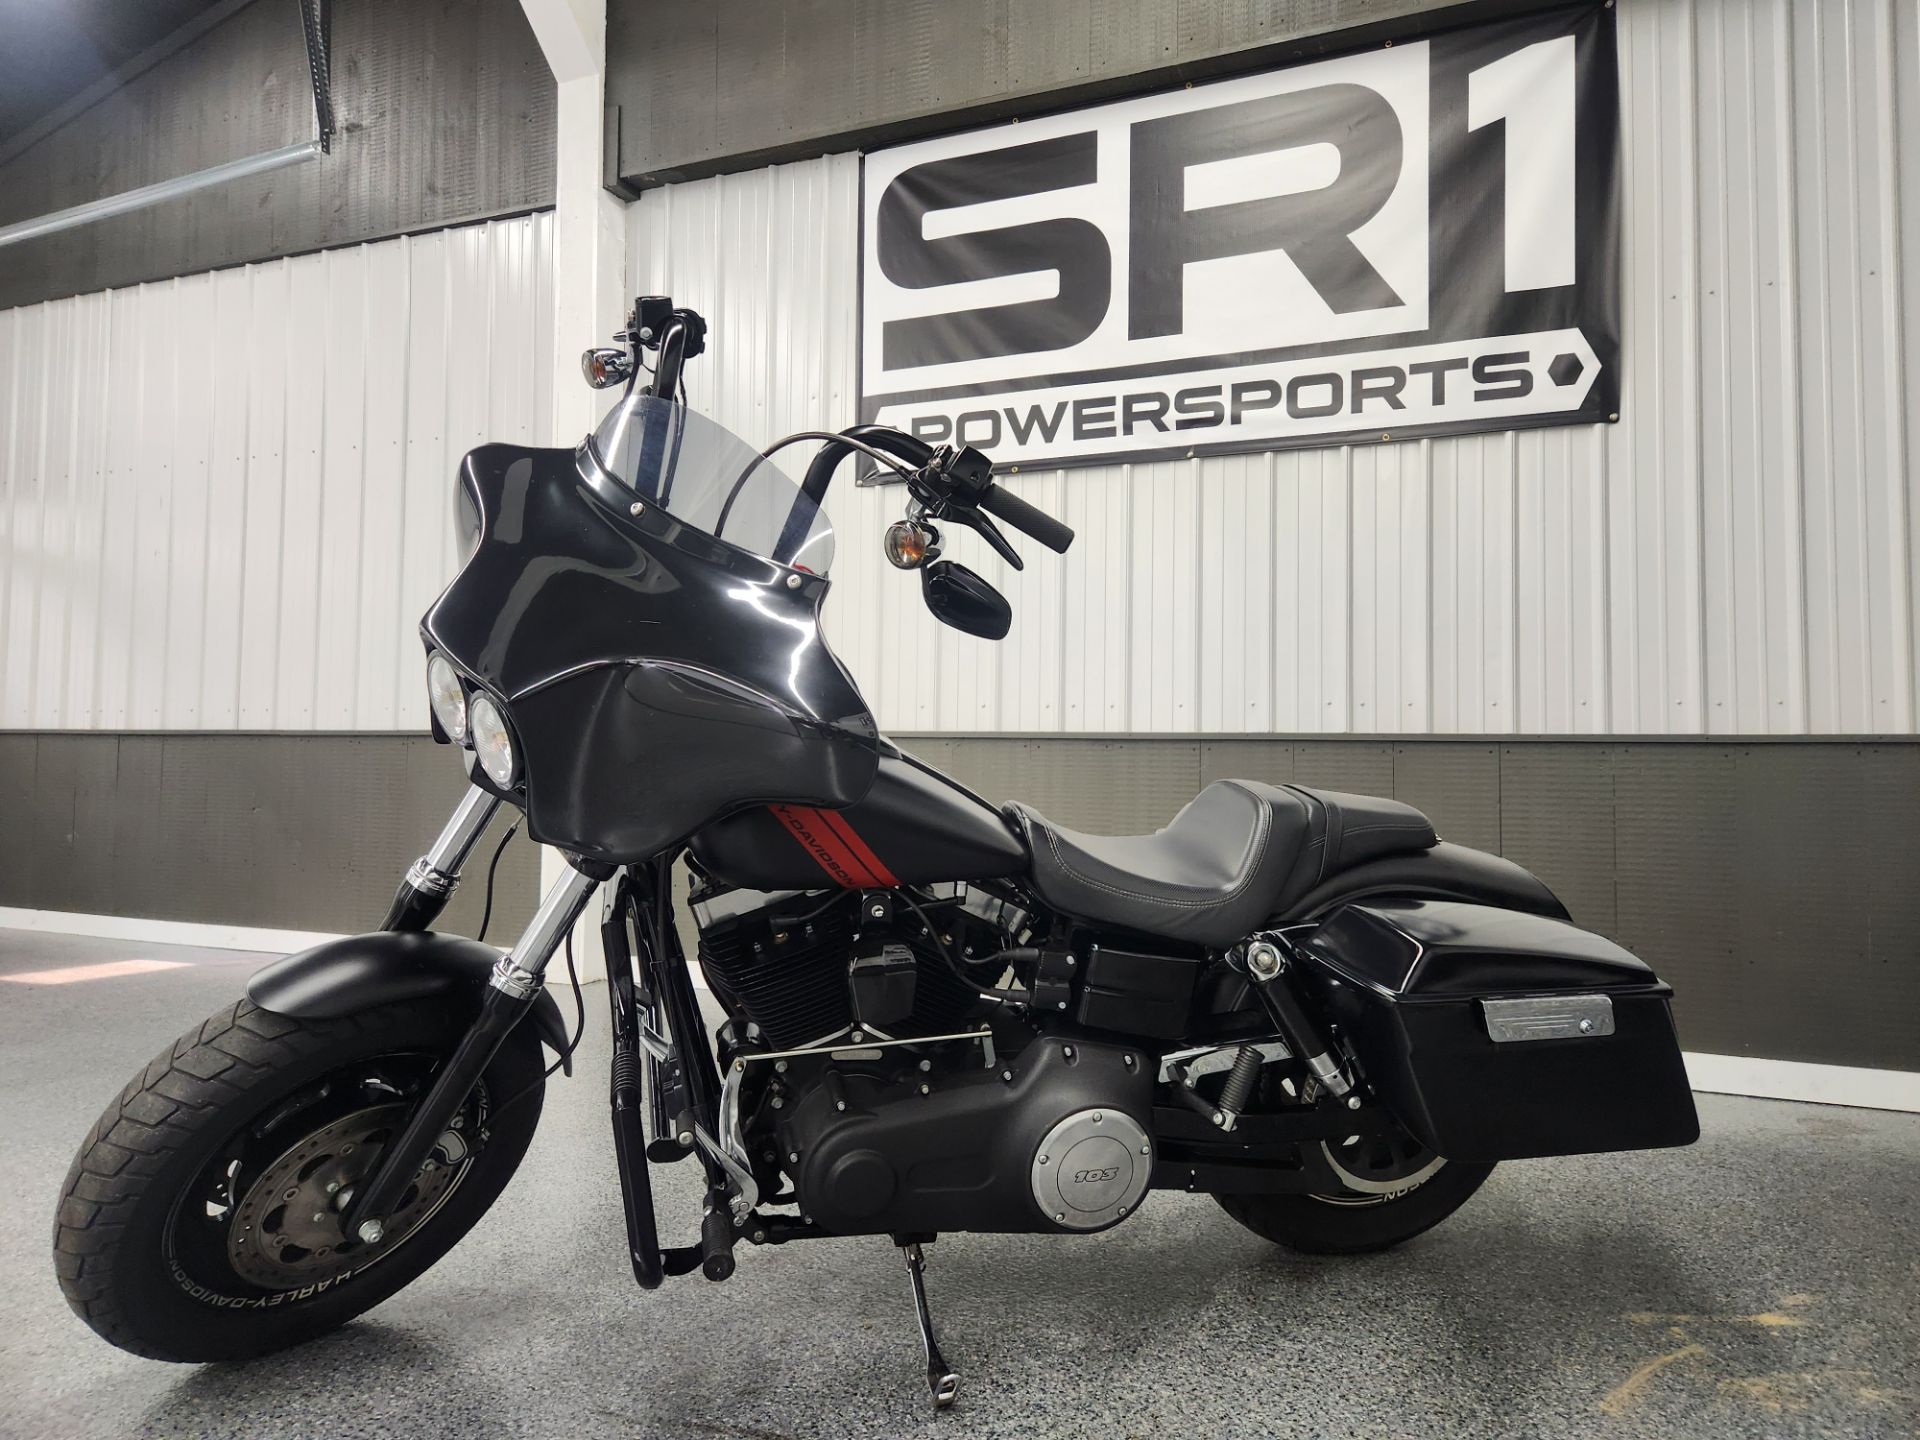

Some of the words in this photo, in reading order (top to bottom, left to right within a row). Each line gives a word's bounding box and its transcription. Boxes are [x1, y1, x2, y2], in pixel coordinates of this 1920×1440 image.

[877, 35, 1576, 371] SR1
[911, 351, 1534, 450] POWERSPORTS
[1075, 1167, 1119, 1183] 103
